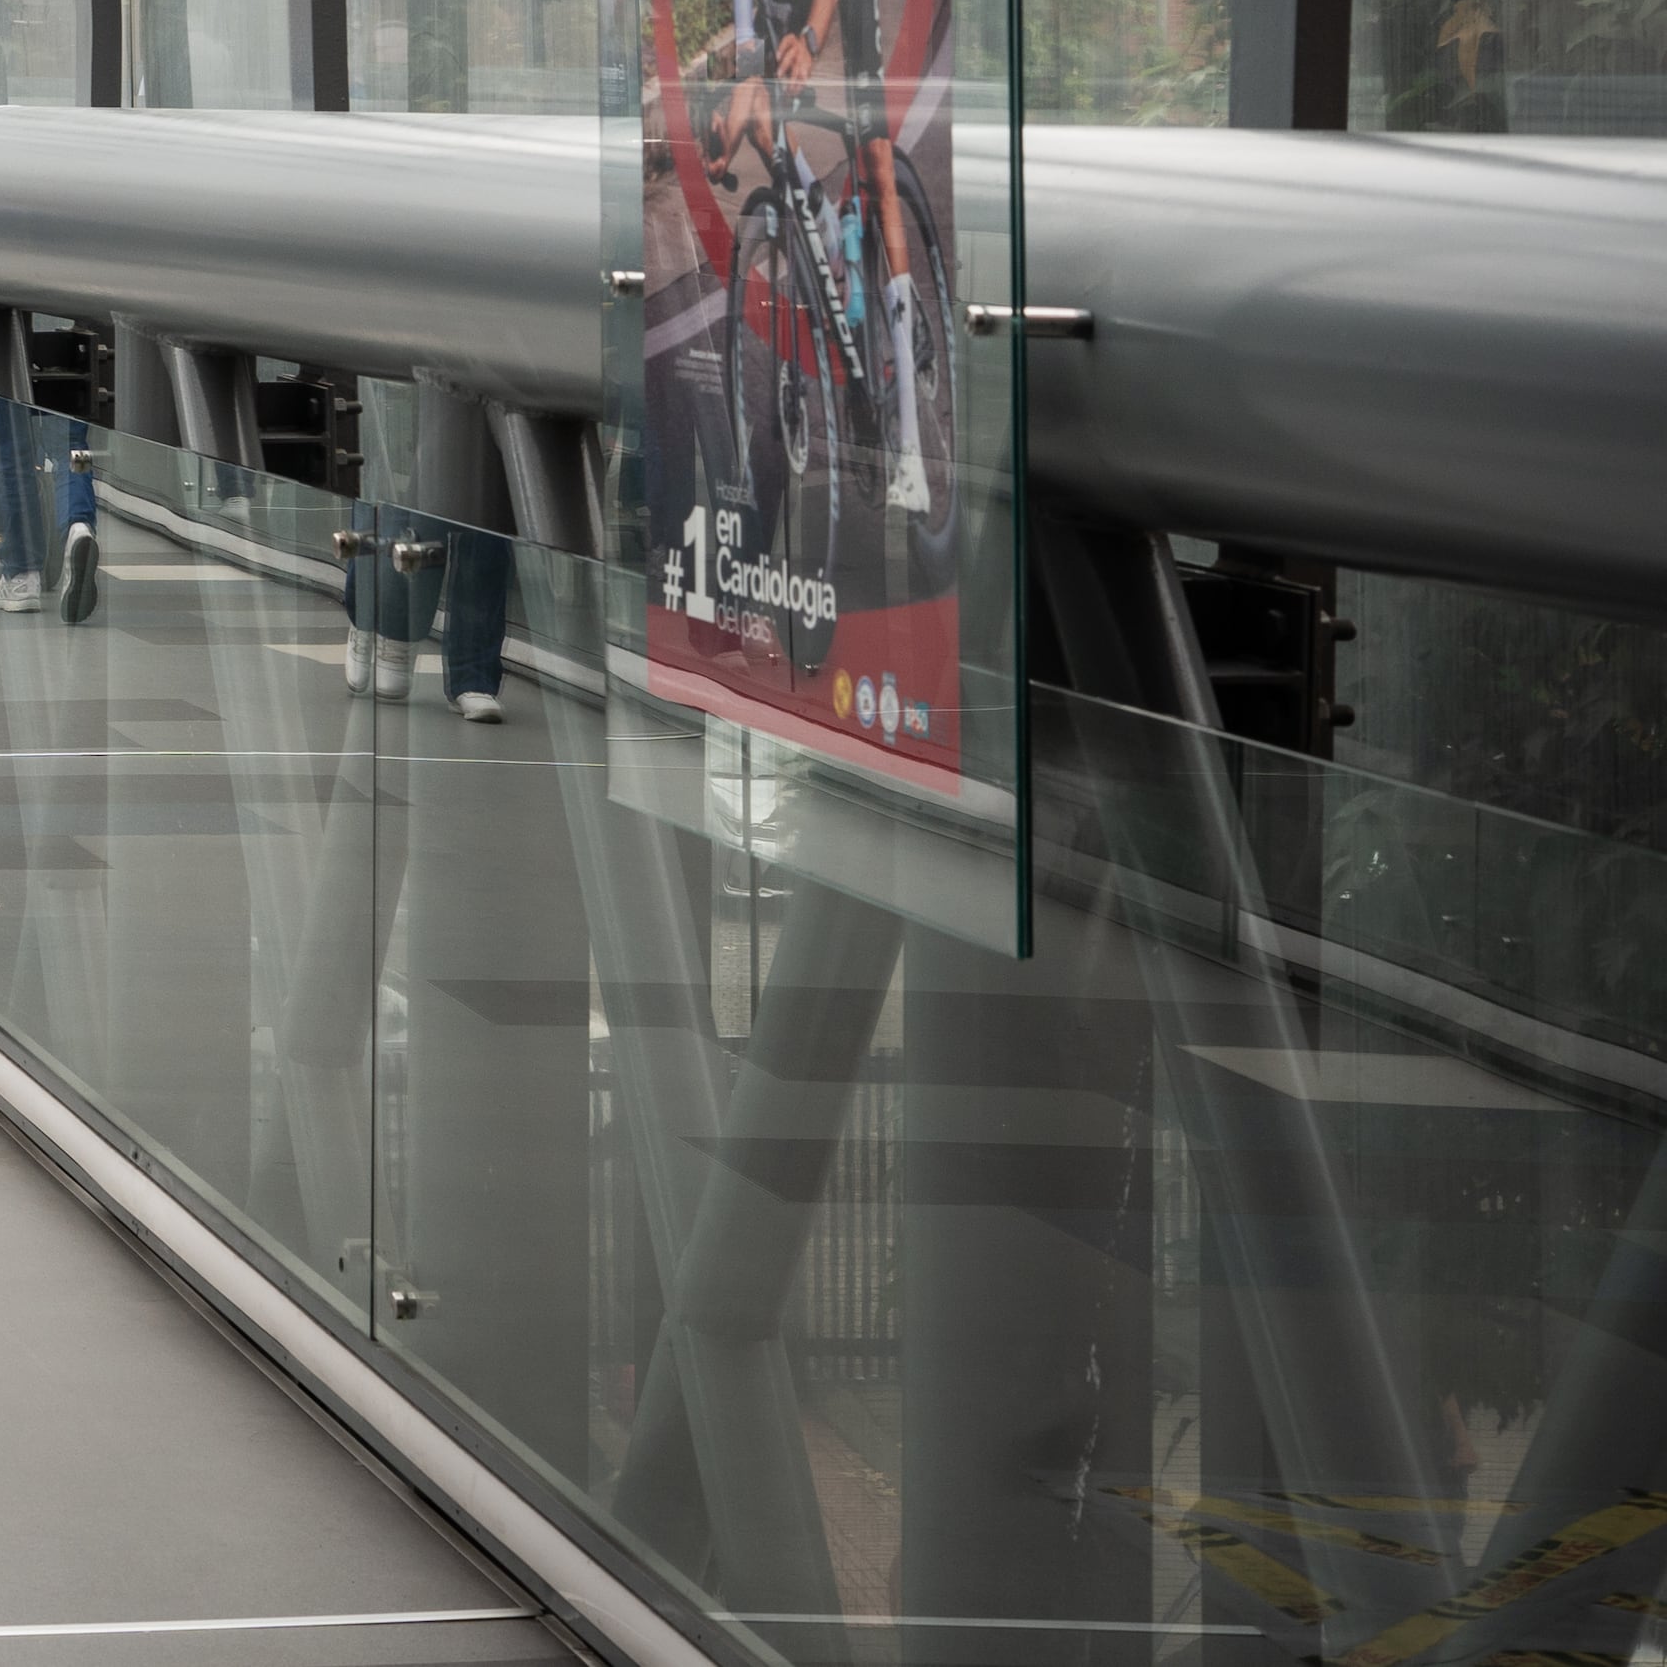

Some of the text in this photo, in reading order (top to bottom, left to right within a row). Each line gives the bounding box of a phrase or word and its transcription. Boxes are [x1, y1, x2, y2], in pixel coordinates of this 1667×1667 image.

[793, 188, 864, 379] MERIDA
[663, 504, 742, 624] #1 en
[716, 545, 837, 629] Cardiología
[716, 594, 741, 635] del
